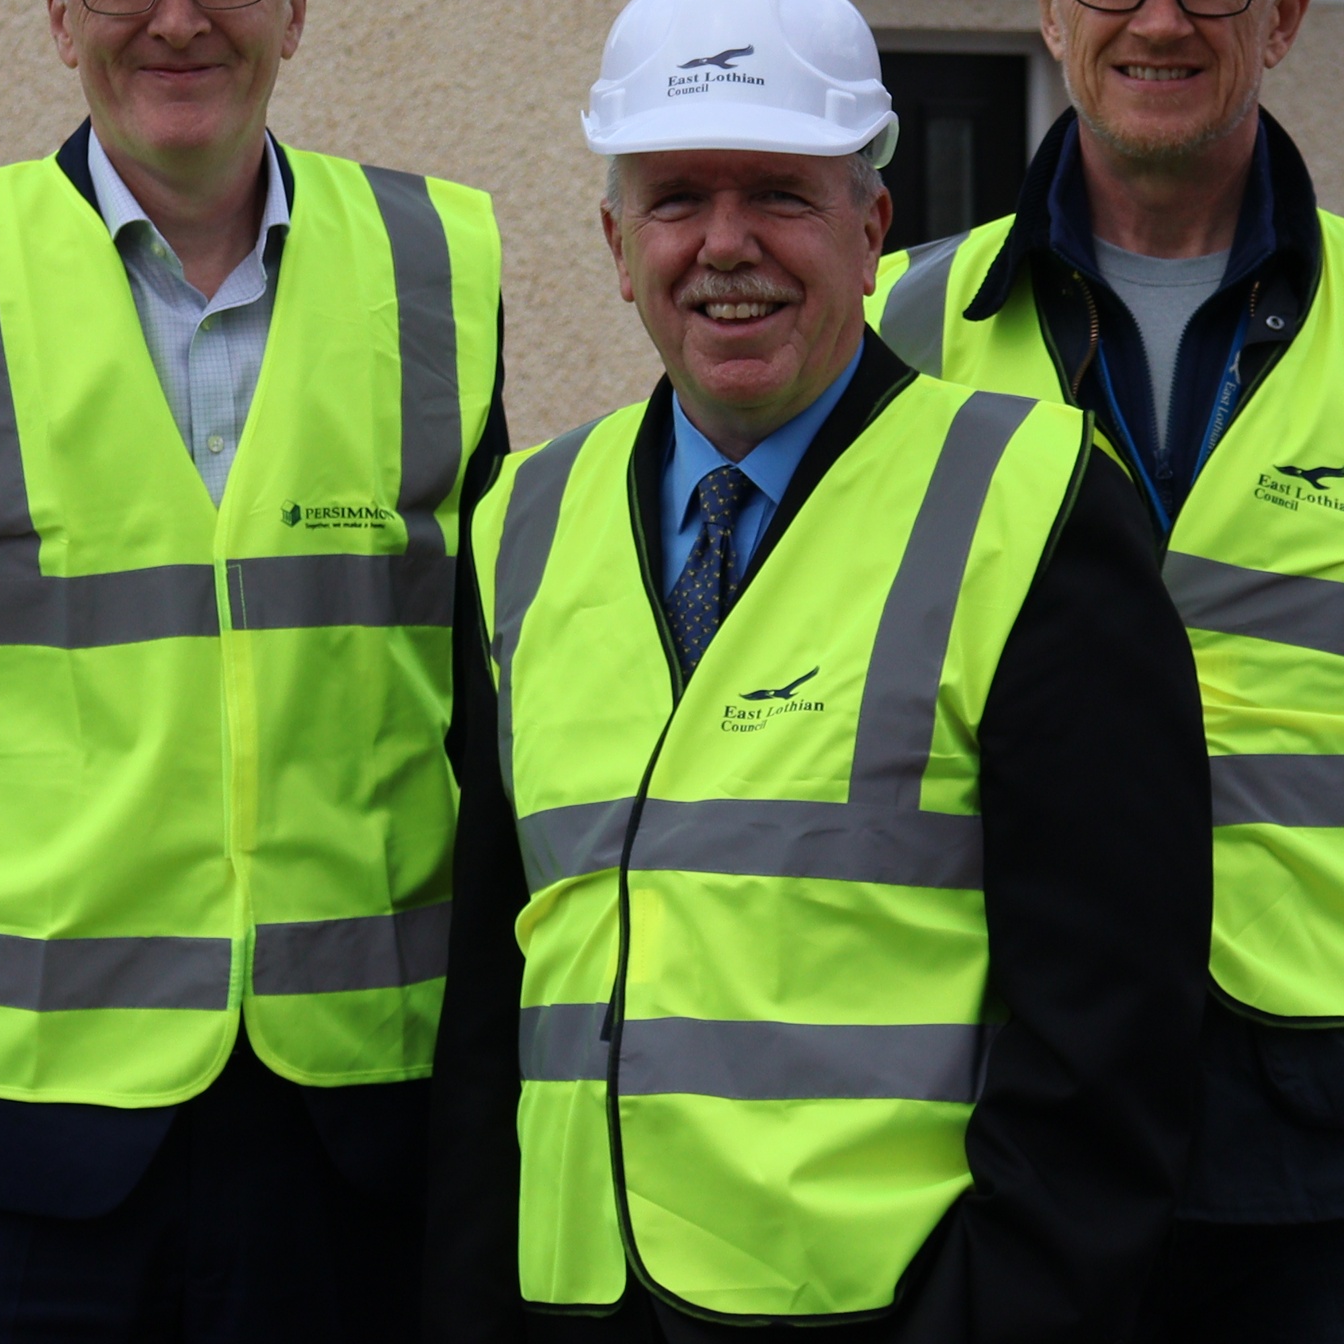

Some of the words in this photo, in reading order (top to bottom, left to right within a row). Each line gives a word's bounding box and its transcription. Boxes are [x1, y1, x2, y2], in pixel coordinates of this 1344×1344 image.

[668, 74, 698, 86] East
[705, 72, 765, 85] Lothian
[667, 83, 709, 97] Council
[1220, 381, 1236, 406] East
[1257, 473, 1291, 495] East
[1254, 487, 1299, 512] Council
[722, 705, 762, 720] East
[766, 699, 824, 717] Lothian
[721, 720, 767, 732] Council
